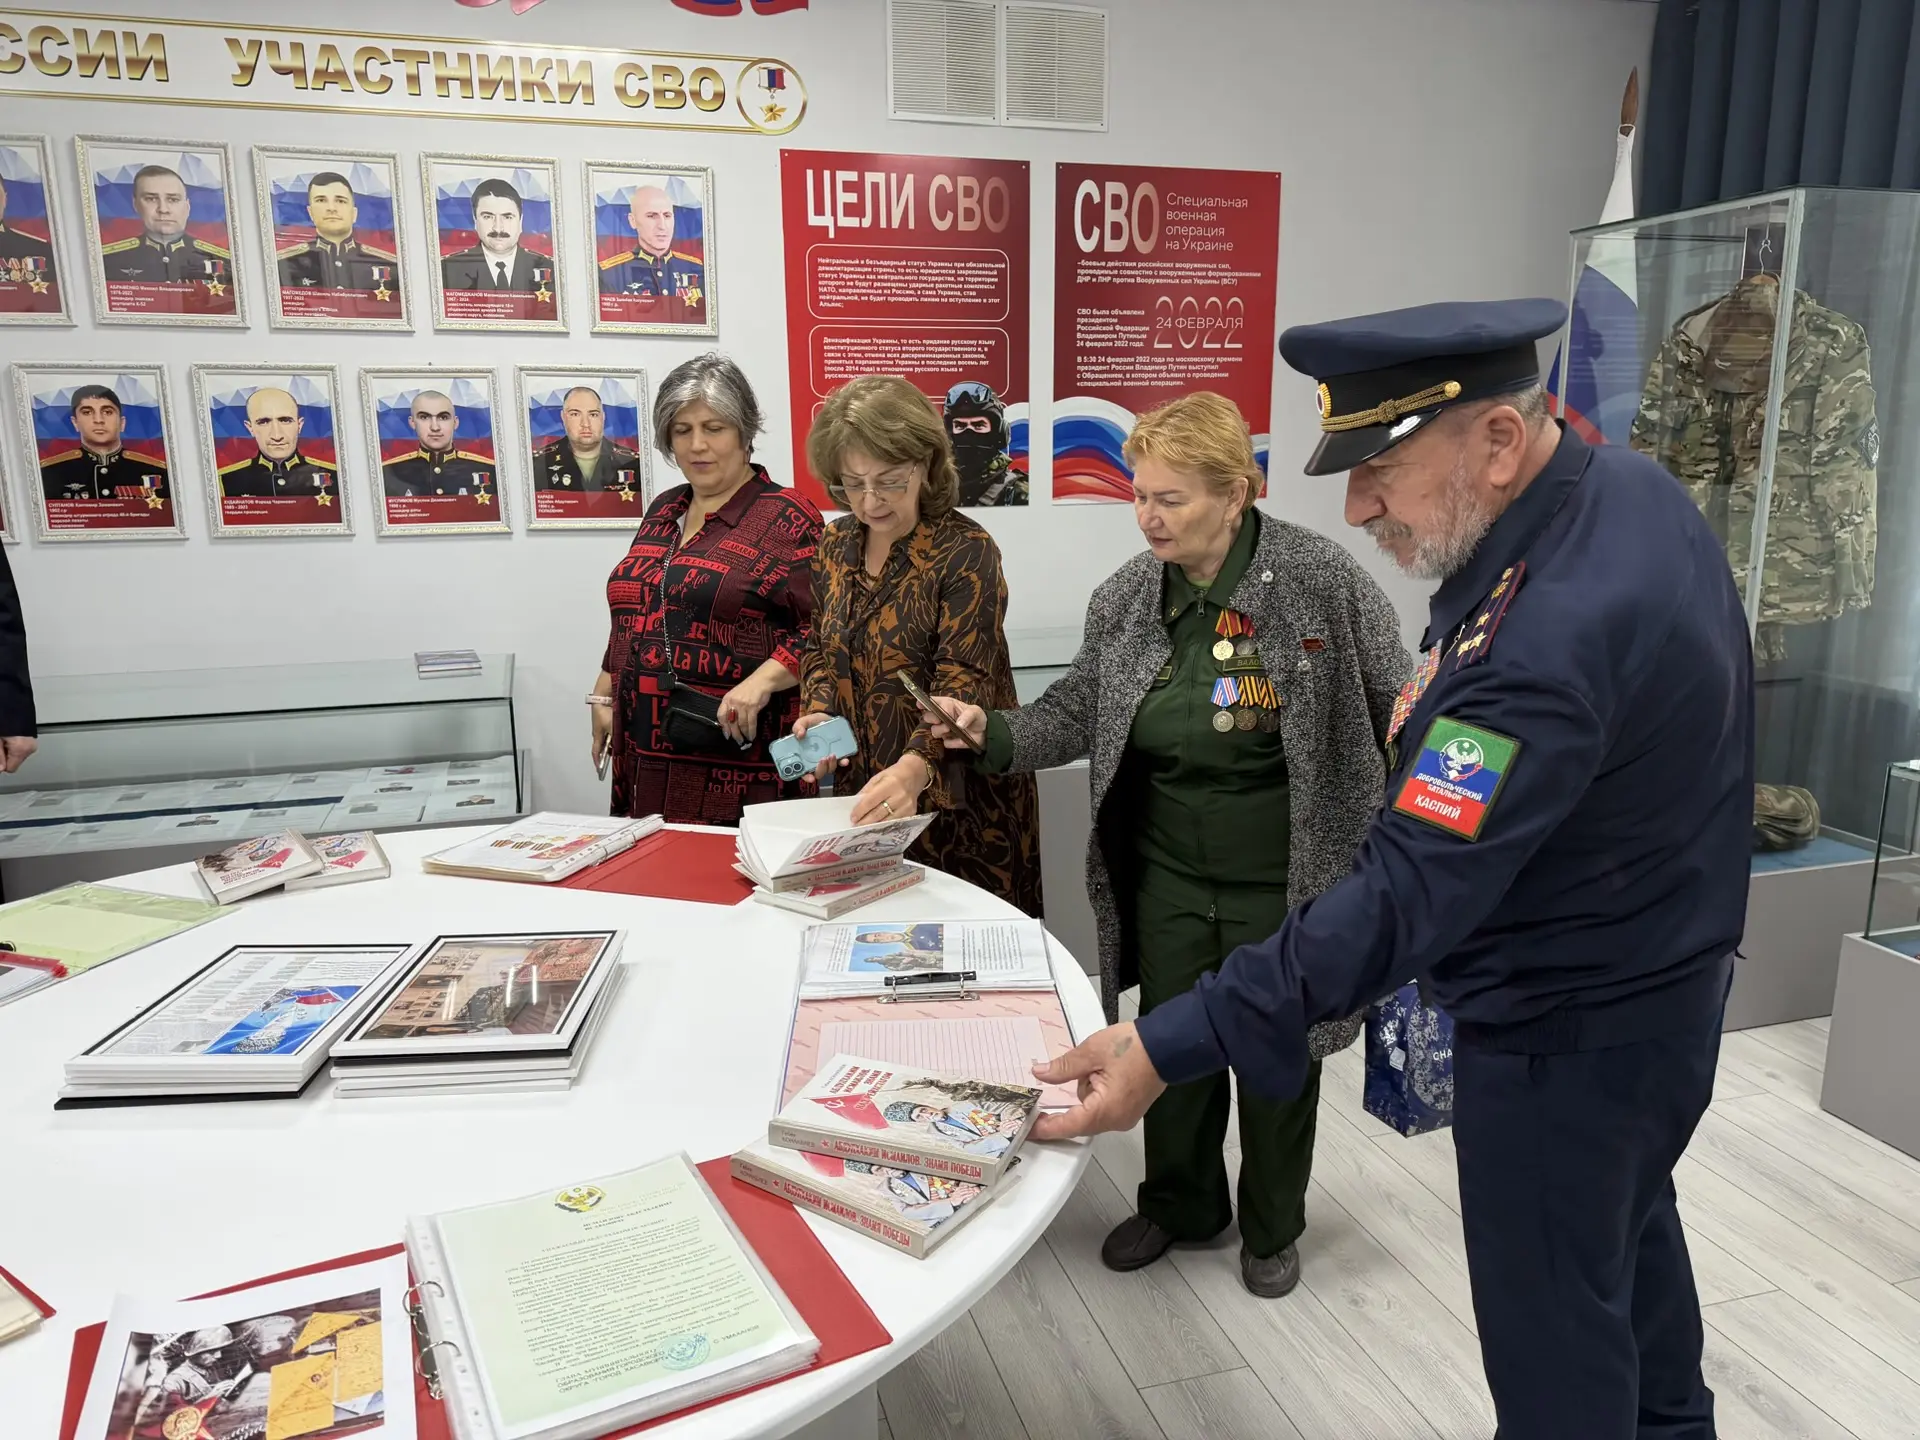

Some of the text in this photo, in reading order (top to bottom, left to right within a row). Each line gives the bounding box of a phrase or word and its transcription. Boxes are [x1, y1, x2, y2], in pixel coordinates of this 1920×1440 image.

[224, 38, 595, 106] УЧАСТНИКИ
[614, 64, 726, 112] СВО
[806, 169, 1010, 239] ЦЕЛИ СВО
[1166, 192, 1248, 208] Специальная
[1074, 179, 1160, 254] СВО
[1166, 211, 1216, 221] военная
[1166, 226, 1224, 239] операция
[1166, 237, 1233, 253] на Украине
[1154, 296, 1244, 349] 2022
[1156, 317, 1243, 328] 24 ФЕВРАЛЯ
[1416, 772, 1483, 801] ДОБРОВОЛЬЧЕСКИЙ
[1427, 784, 1462, 802] БАТАЛЬОН
[1414, 794, 1461, 820] КАСПИЙ
[924, 1157, 948, 1172] ЗНАМЯ
[951, 1162, 982, 1178] ПОБЕДЫ
[860, 1215, 881, 1234] ЗНАМЯ
[883, 1224, 912, 1247] ПОБЕДЫ
